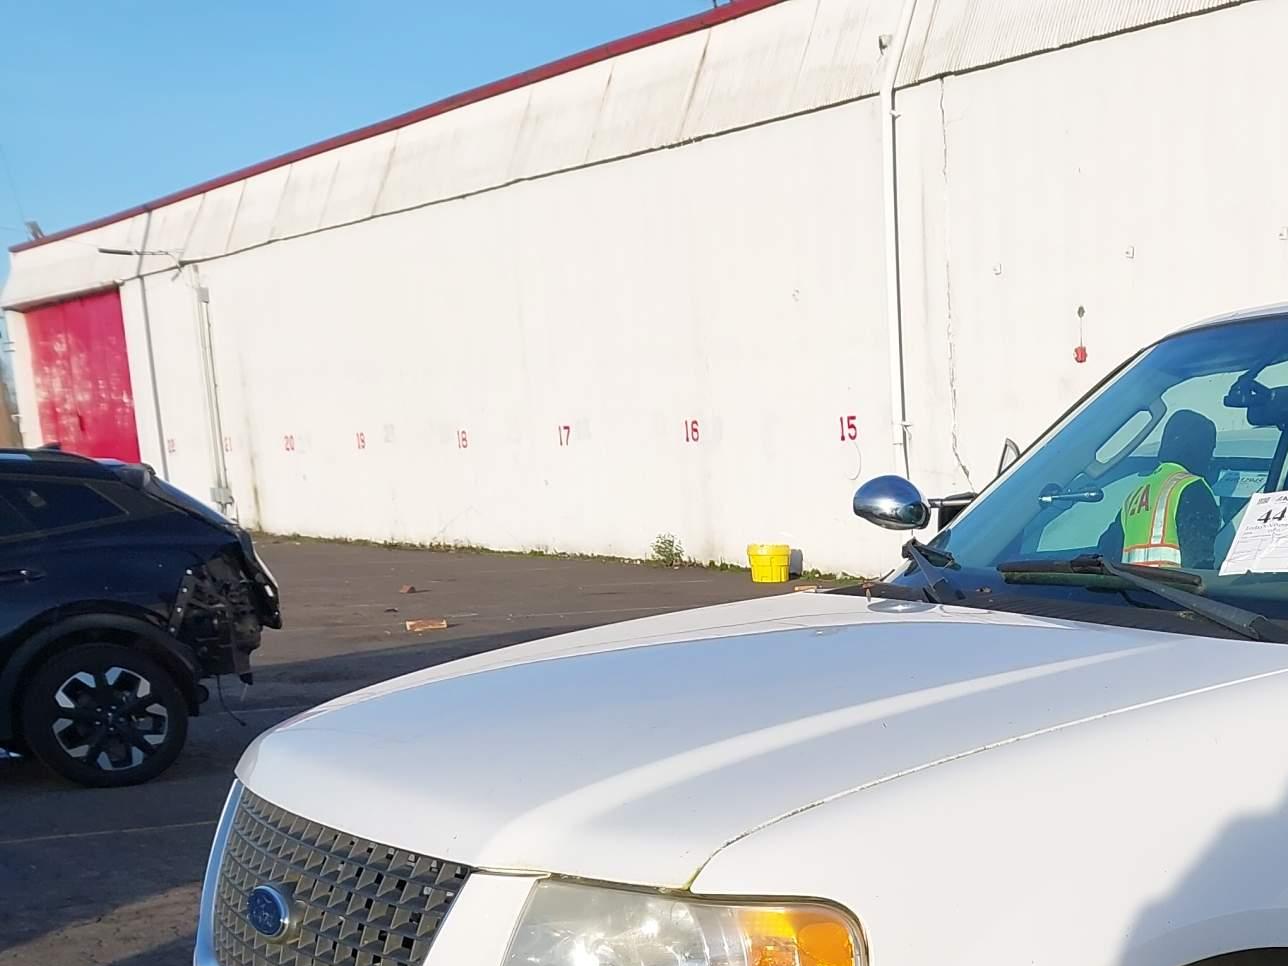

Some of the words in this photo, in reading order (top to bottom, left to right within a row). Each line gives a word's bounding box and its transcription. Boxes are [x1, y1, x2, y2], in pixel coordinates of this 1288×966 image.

[456, 430, 468, 449] 18
[557, 424, 571, 447] 17
[684, 419, 700, 443] 16
[839, 415, 857, 442] 15
[283, 434, 295, 452] 20
